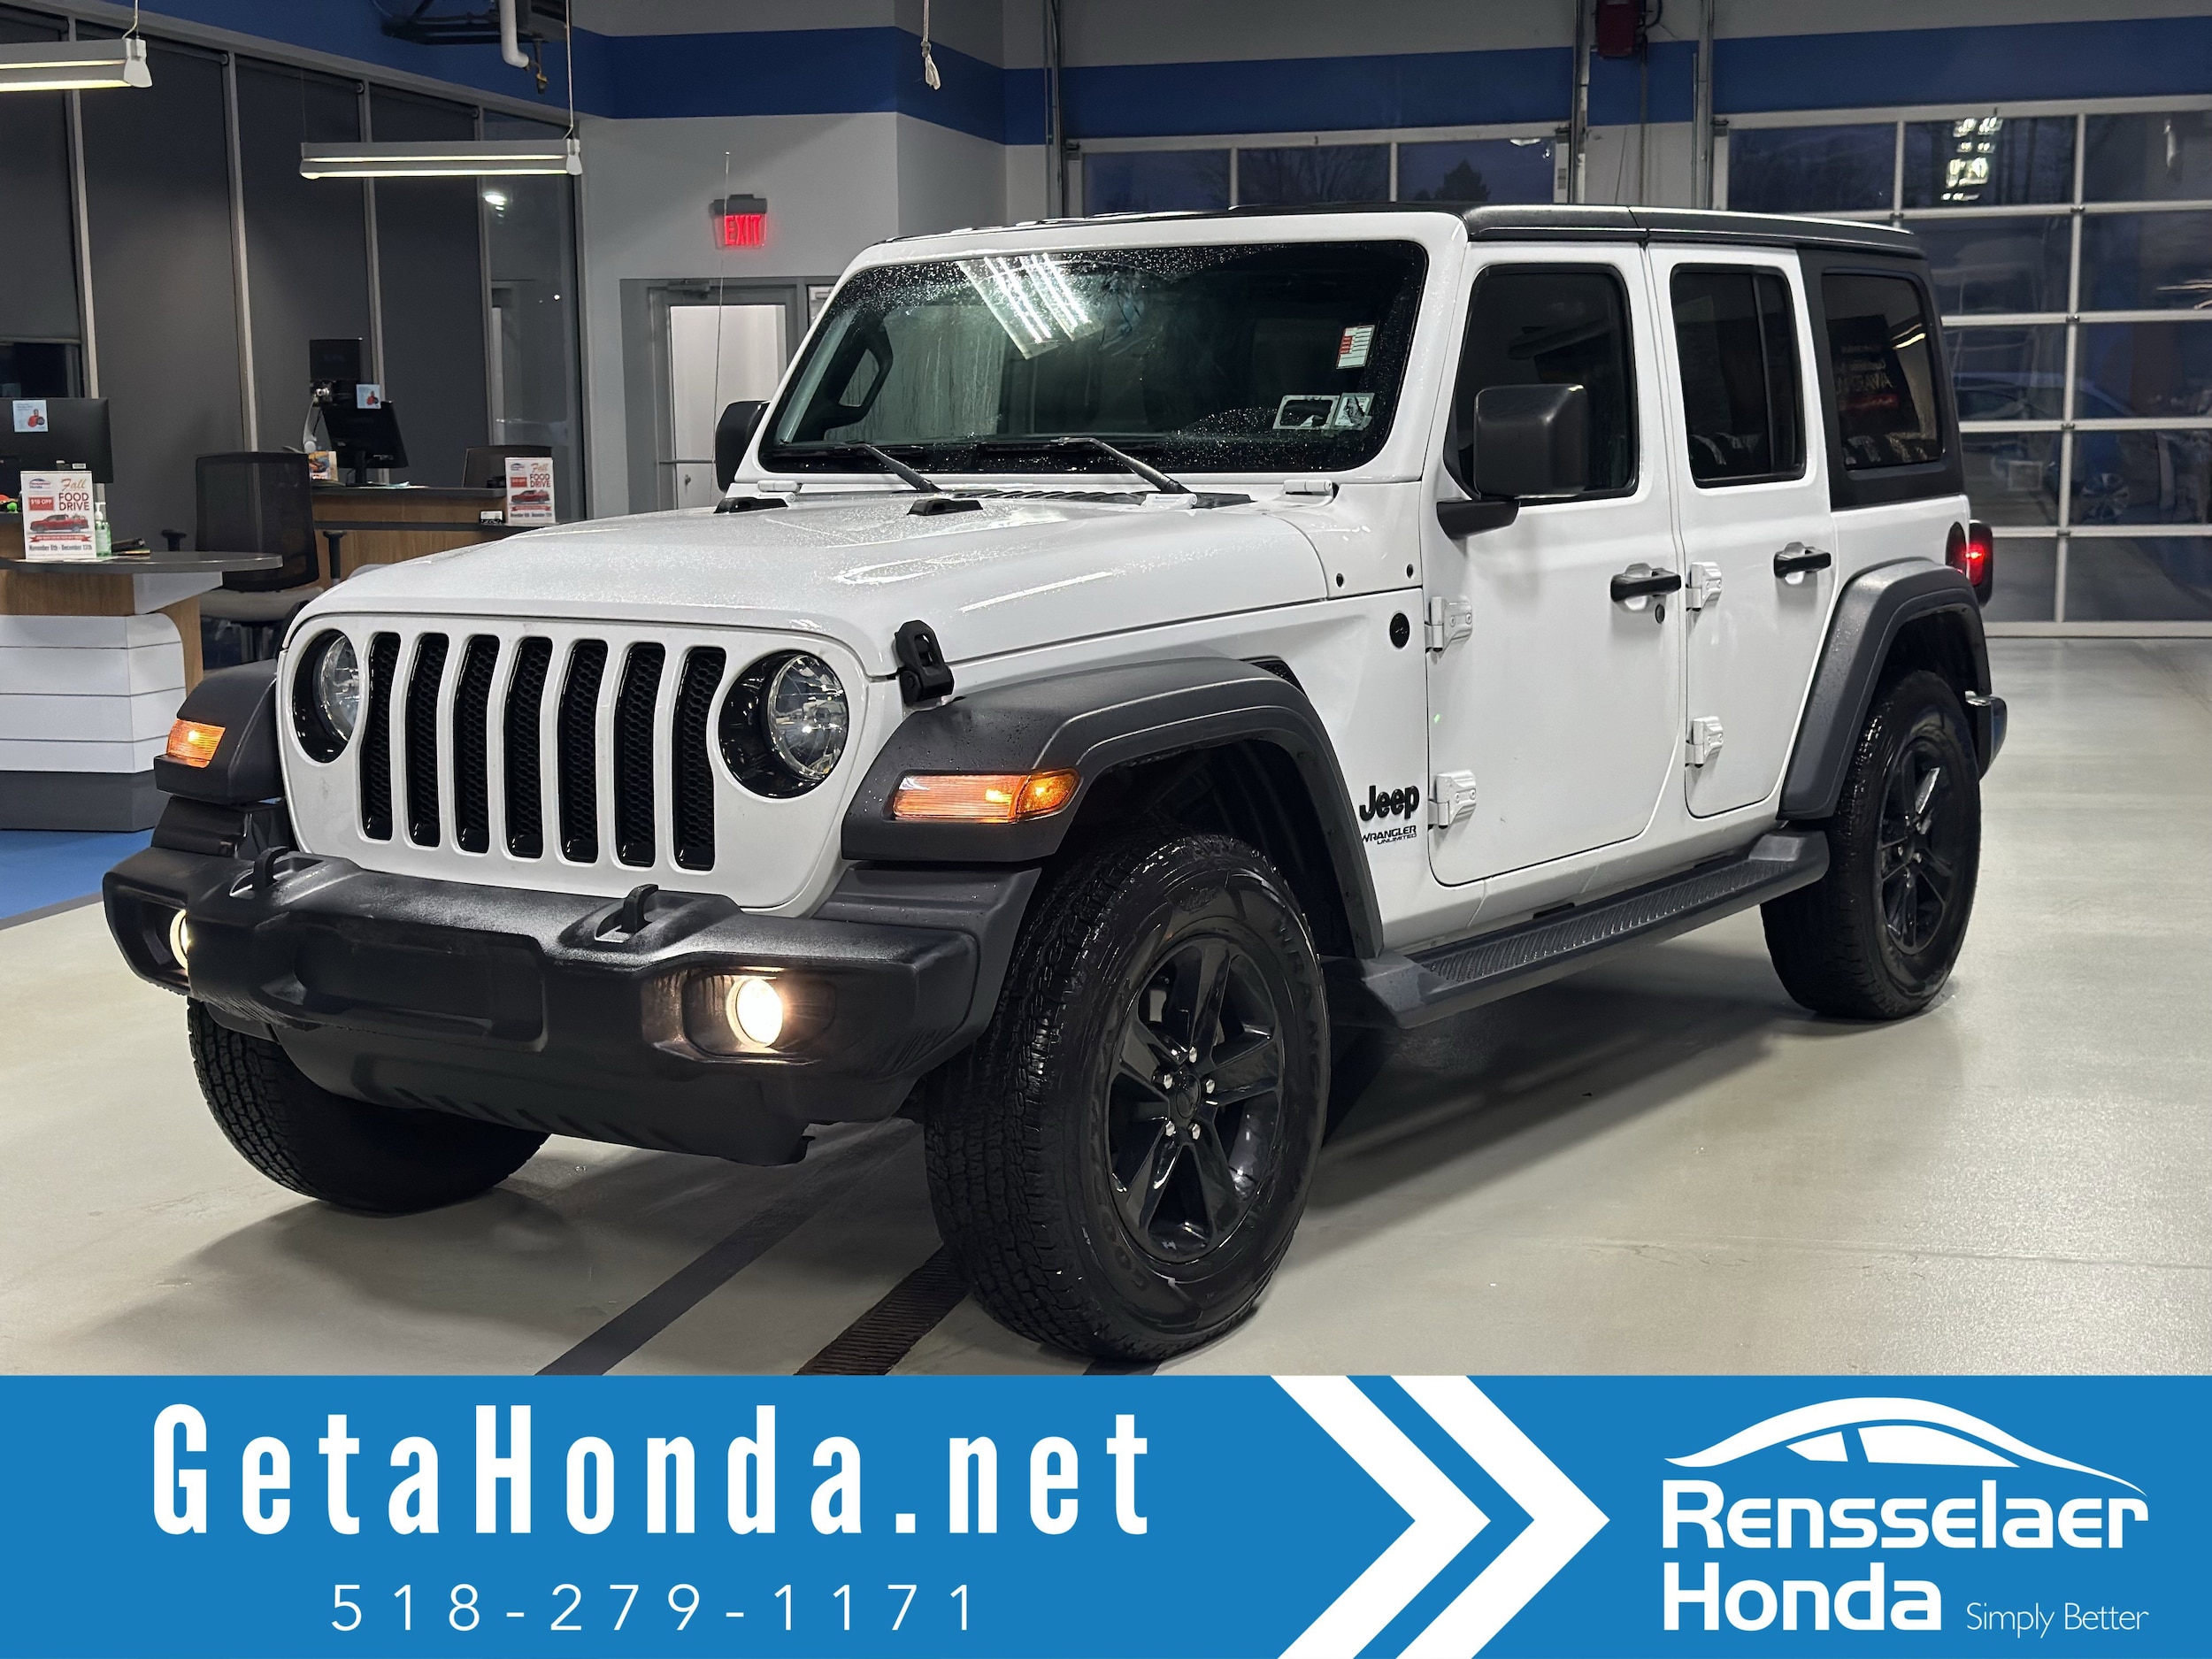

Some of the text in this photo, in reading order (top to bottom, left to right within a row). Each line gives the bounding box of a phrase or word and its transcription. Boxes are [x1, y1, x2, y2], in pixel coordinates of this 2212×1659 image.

[725, 215, 761, 245] EXIT
[61, 478, 87, 491] Fall
[58, 492, 89, 502] FOOD
[59, 502, 90, 511] DRIVE
[1359, 785, 1420, 821] Jeep
[1362, 825, 1417, 843] WRANGLER
[1377, 833, 1417, 845] UNLIMITED
